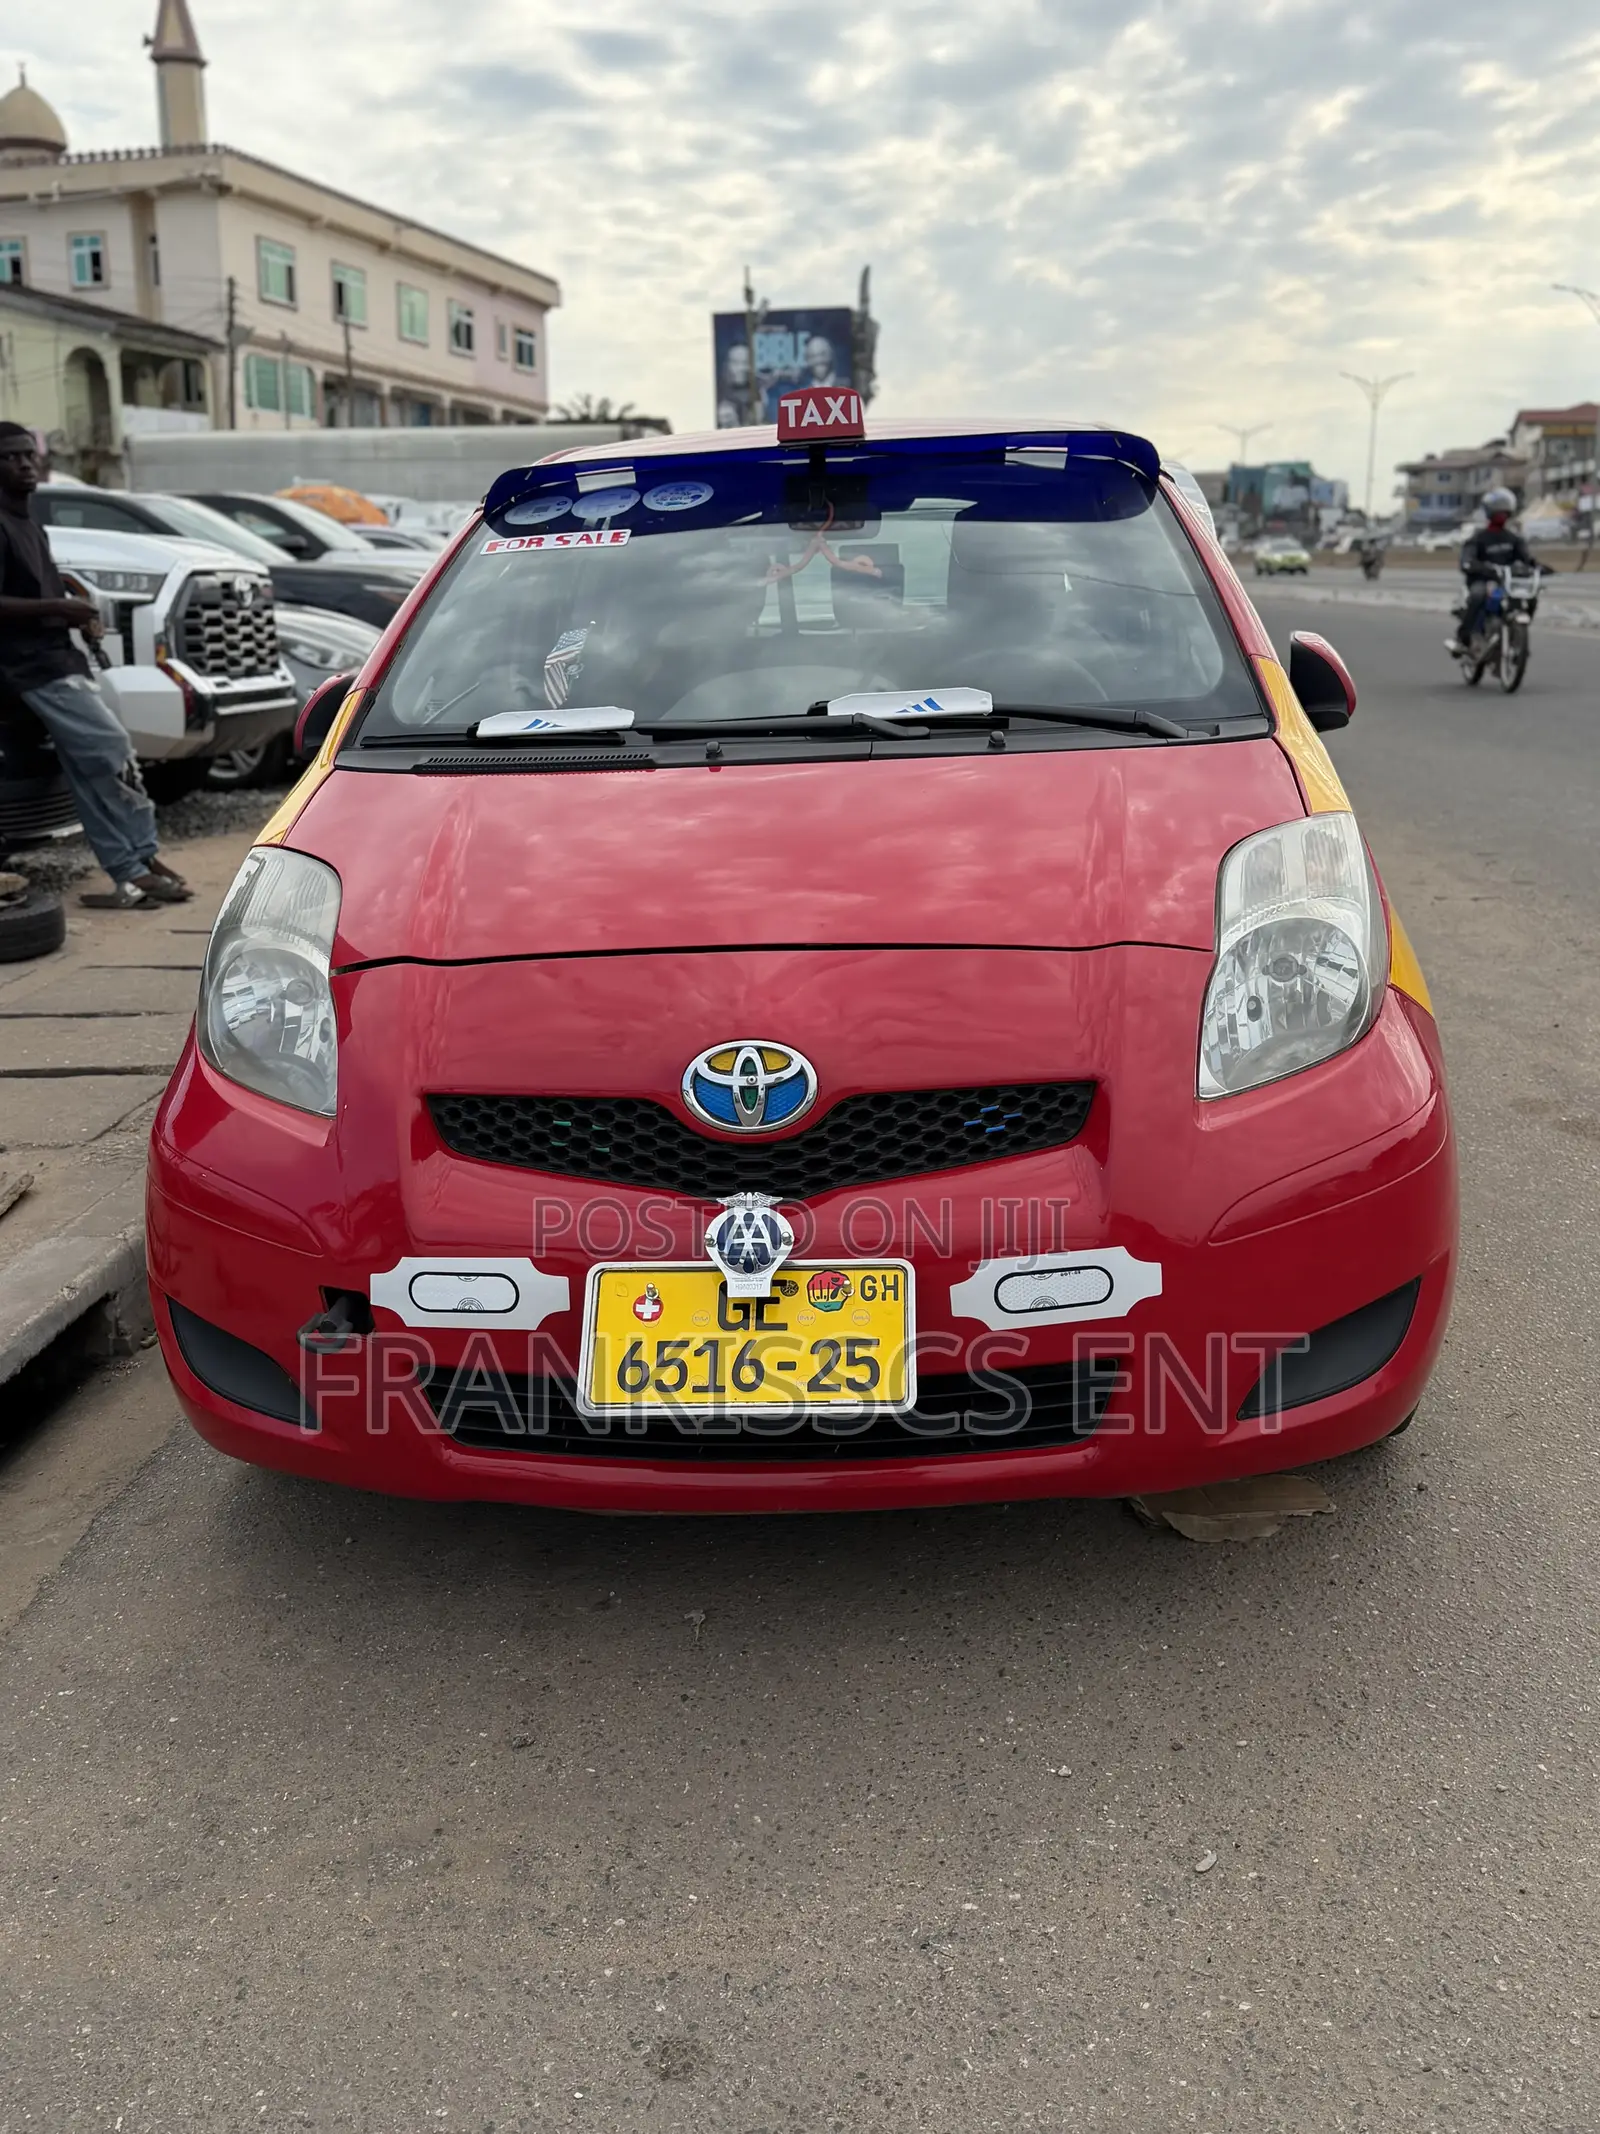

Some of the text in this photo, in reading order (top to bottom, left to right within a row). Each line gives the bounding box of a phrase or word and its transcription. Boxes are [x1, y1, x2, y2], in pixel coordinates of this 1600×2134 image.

[780, 395, 859, 428] TAXI
[485, 531, 628, 553] FOR SALE
[860, 1274, 899, 1302] GH
[717, 1279, 788, 1332] GE
[617, 1338, 881, 1394] 6516-25
